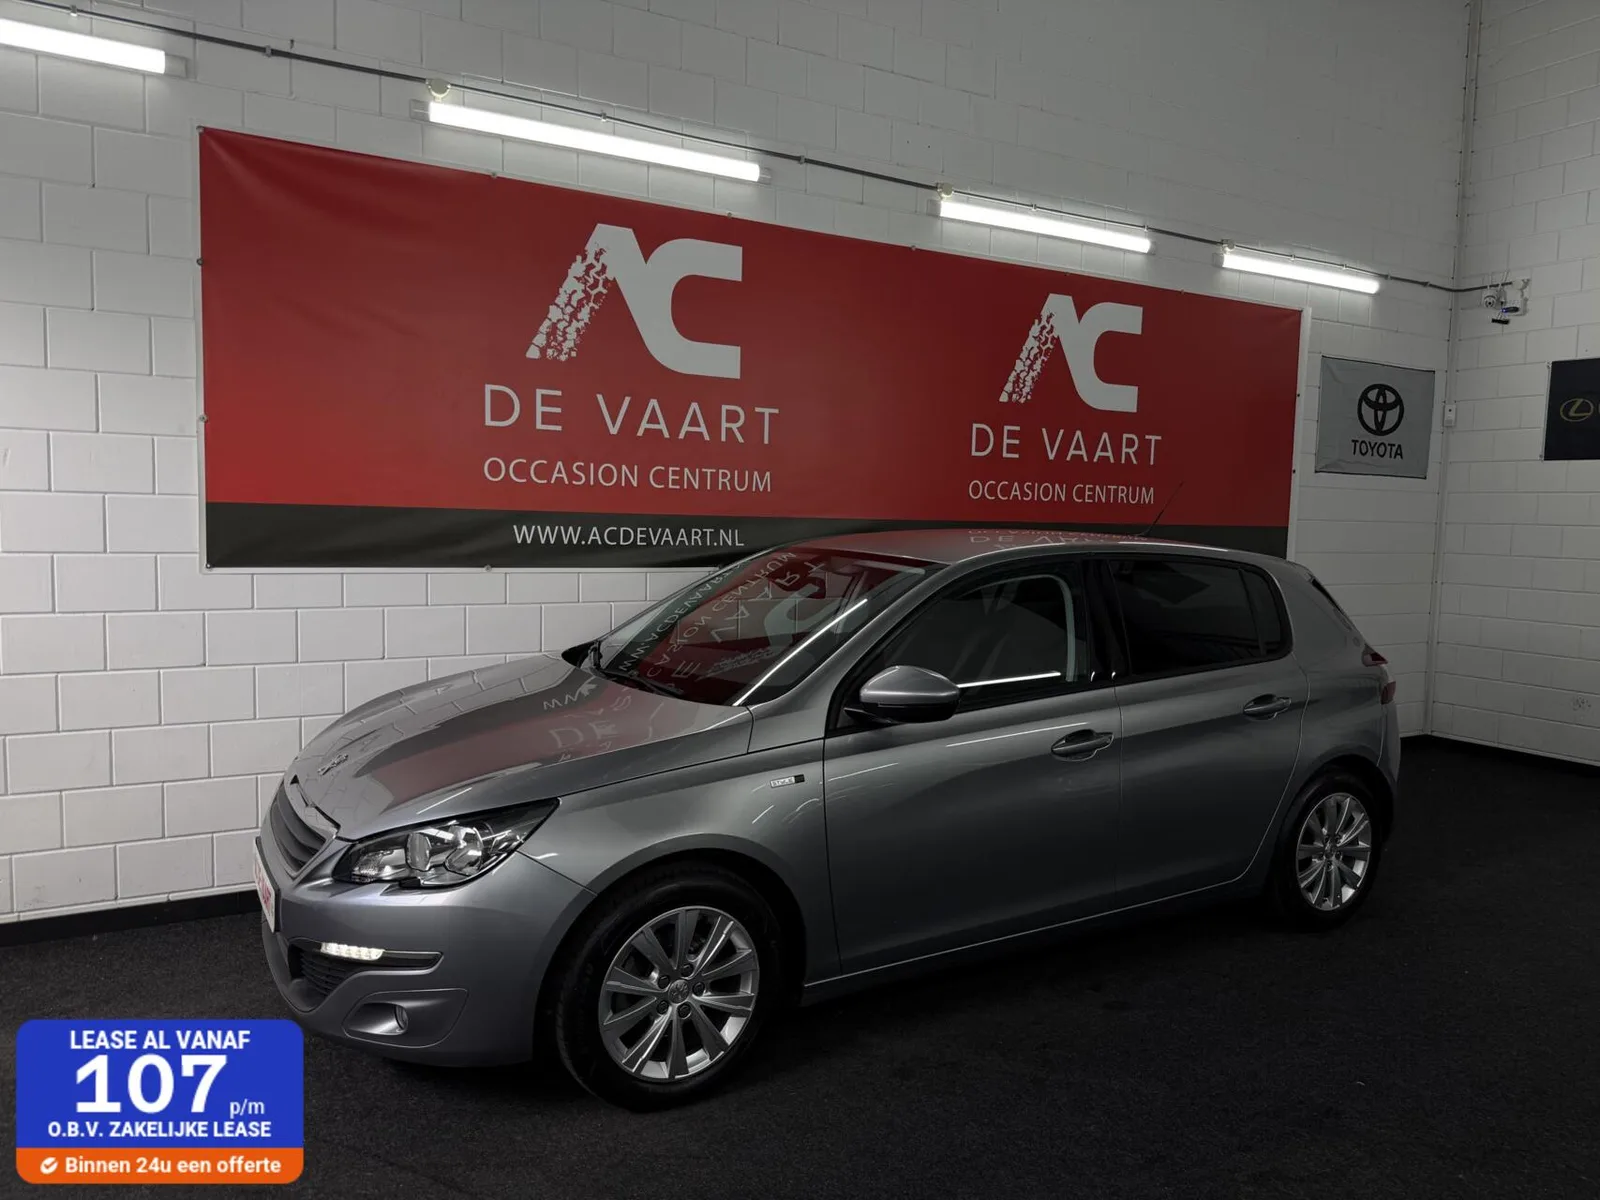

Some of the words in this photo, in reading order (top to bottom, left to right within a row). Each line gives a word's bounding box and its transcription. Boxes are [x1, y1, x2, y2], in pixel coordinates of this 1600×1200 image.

[526, 223, 743, 379] AC
[999, 293, 1143, 413] AC
[484, 383, 563, 432] DE
[596, 393, 780, 444] VAART
[971, 423, 1021, 459] DE
[1041, 427, 1162, 466] VAART
[1351, 438, 1403, 460] TOYOTA
[483, 457, 638, 487] OCCASION
[649, 465, 772, 492] CENTRUM
[968, 480, 1067, 502] OCCASION
[1072, 484, 1154, 504] CENTRUM
[513, 525, 744, 547] WWW.ACDEVAART.NL
